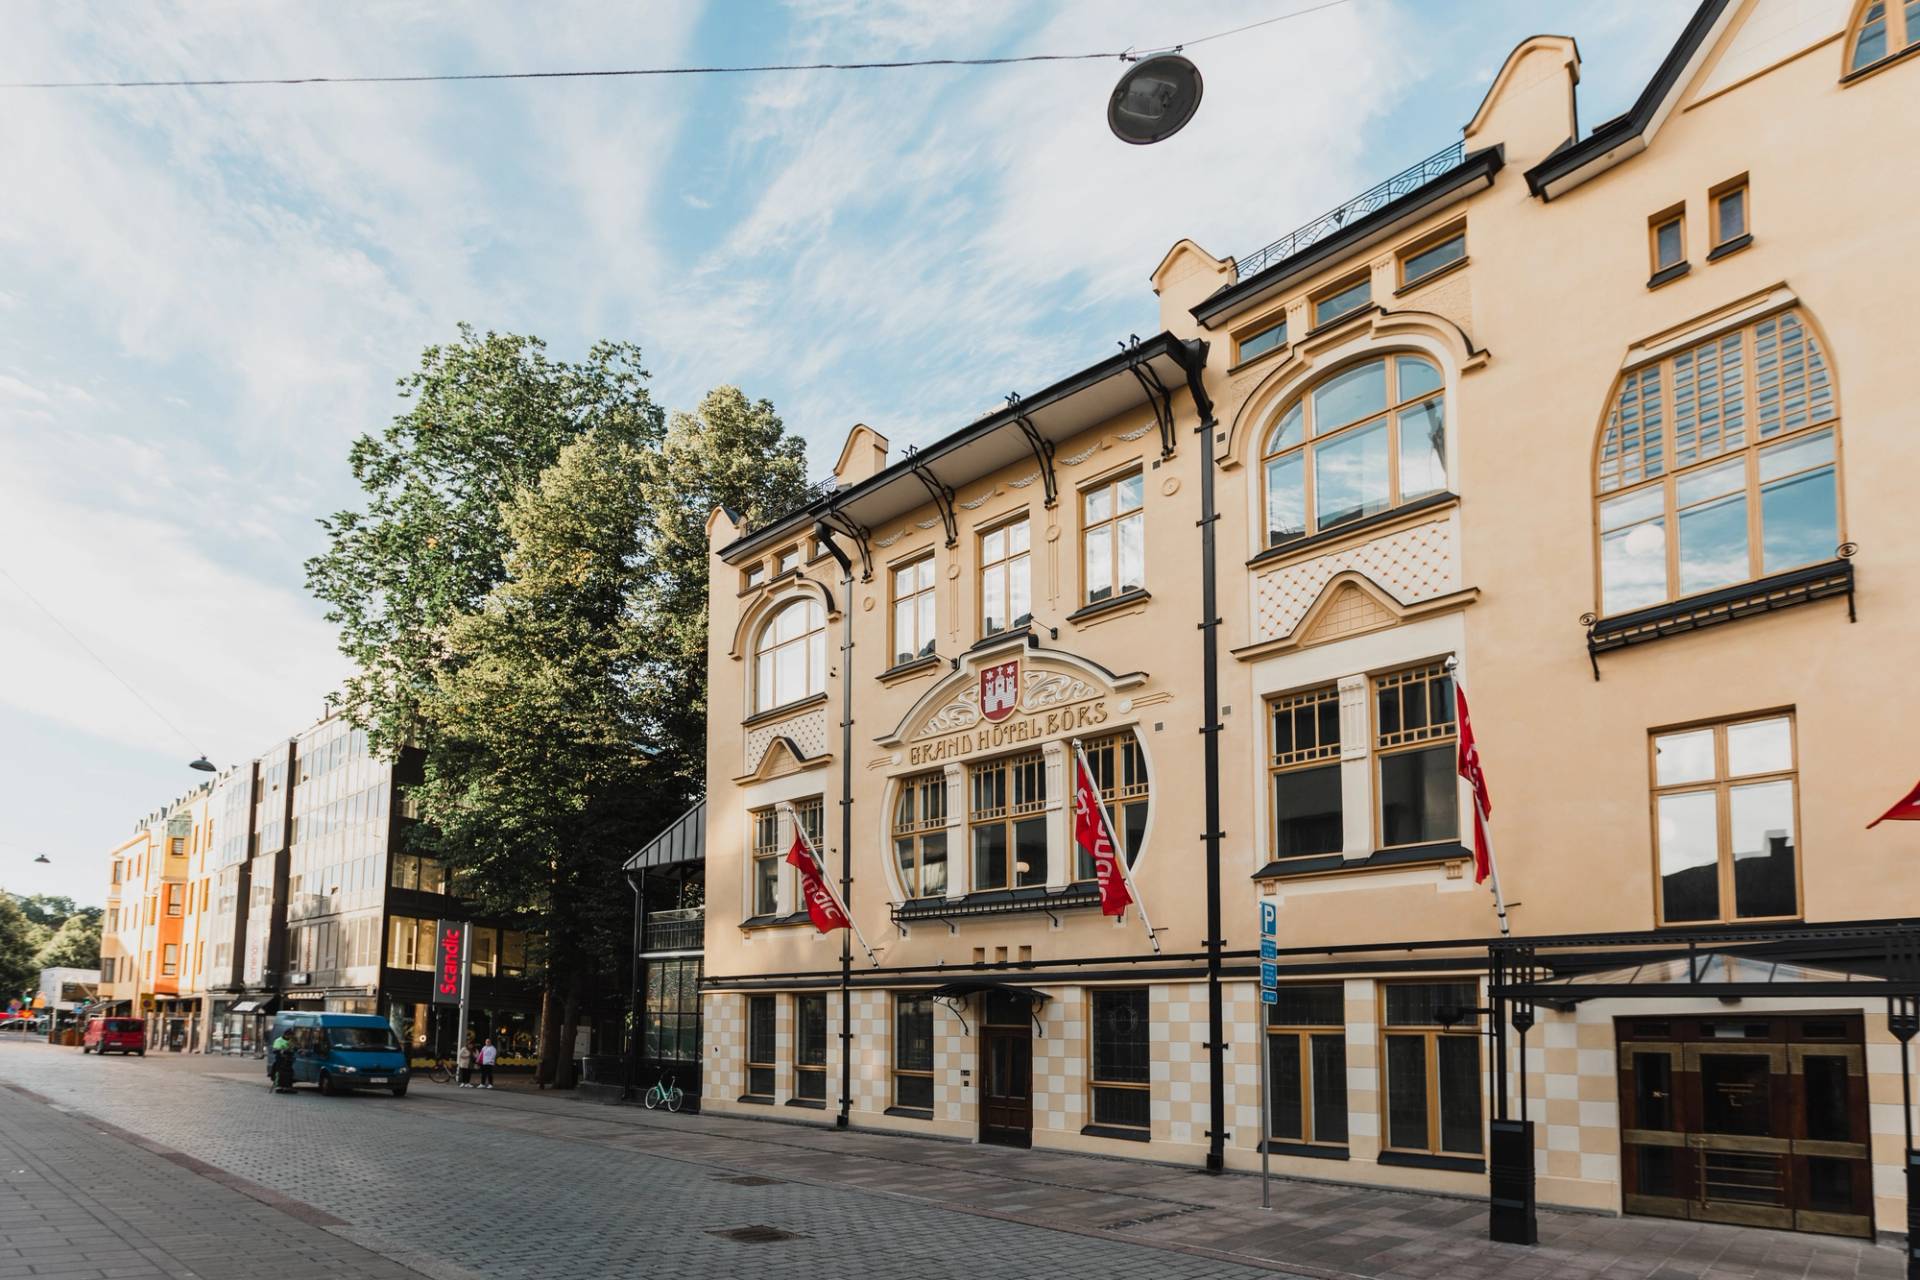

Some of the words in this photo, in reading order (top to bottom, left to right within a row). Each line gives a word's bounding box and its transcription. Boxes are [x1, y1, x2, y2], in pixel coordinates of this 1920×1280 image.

[911, 734, 972, 766] GRAND
[1046, 702, 1108, 735] BÖRS
[1264, 904, 1275, 932] P
[440, 928, 460, 994] Scandic
